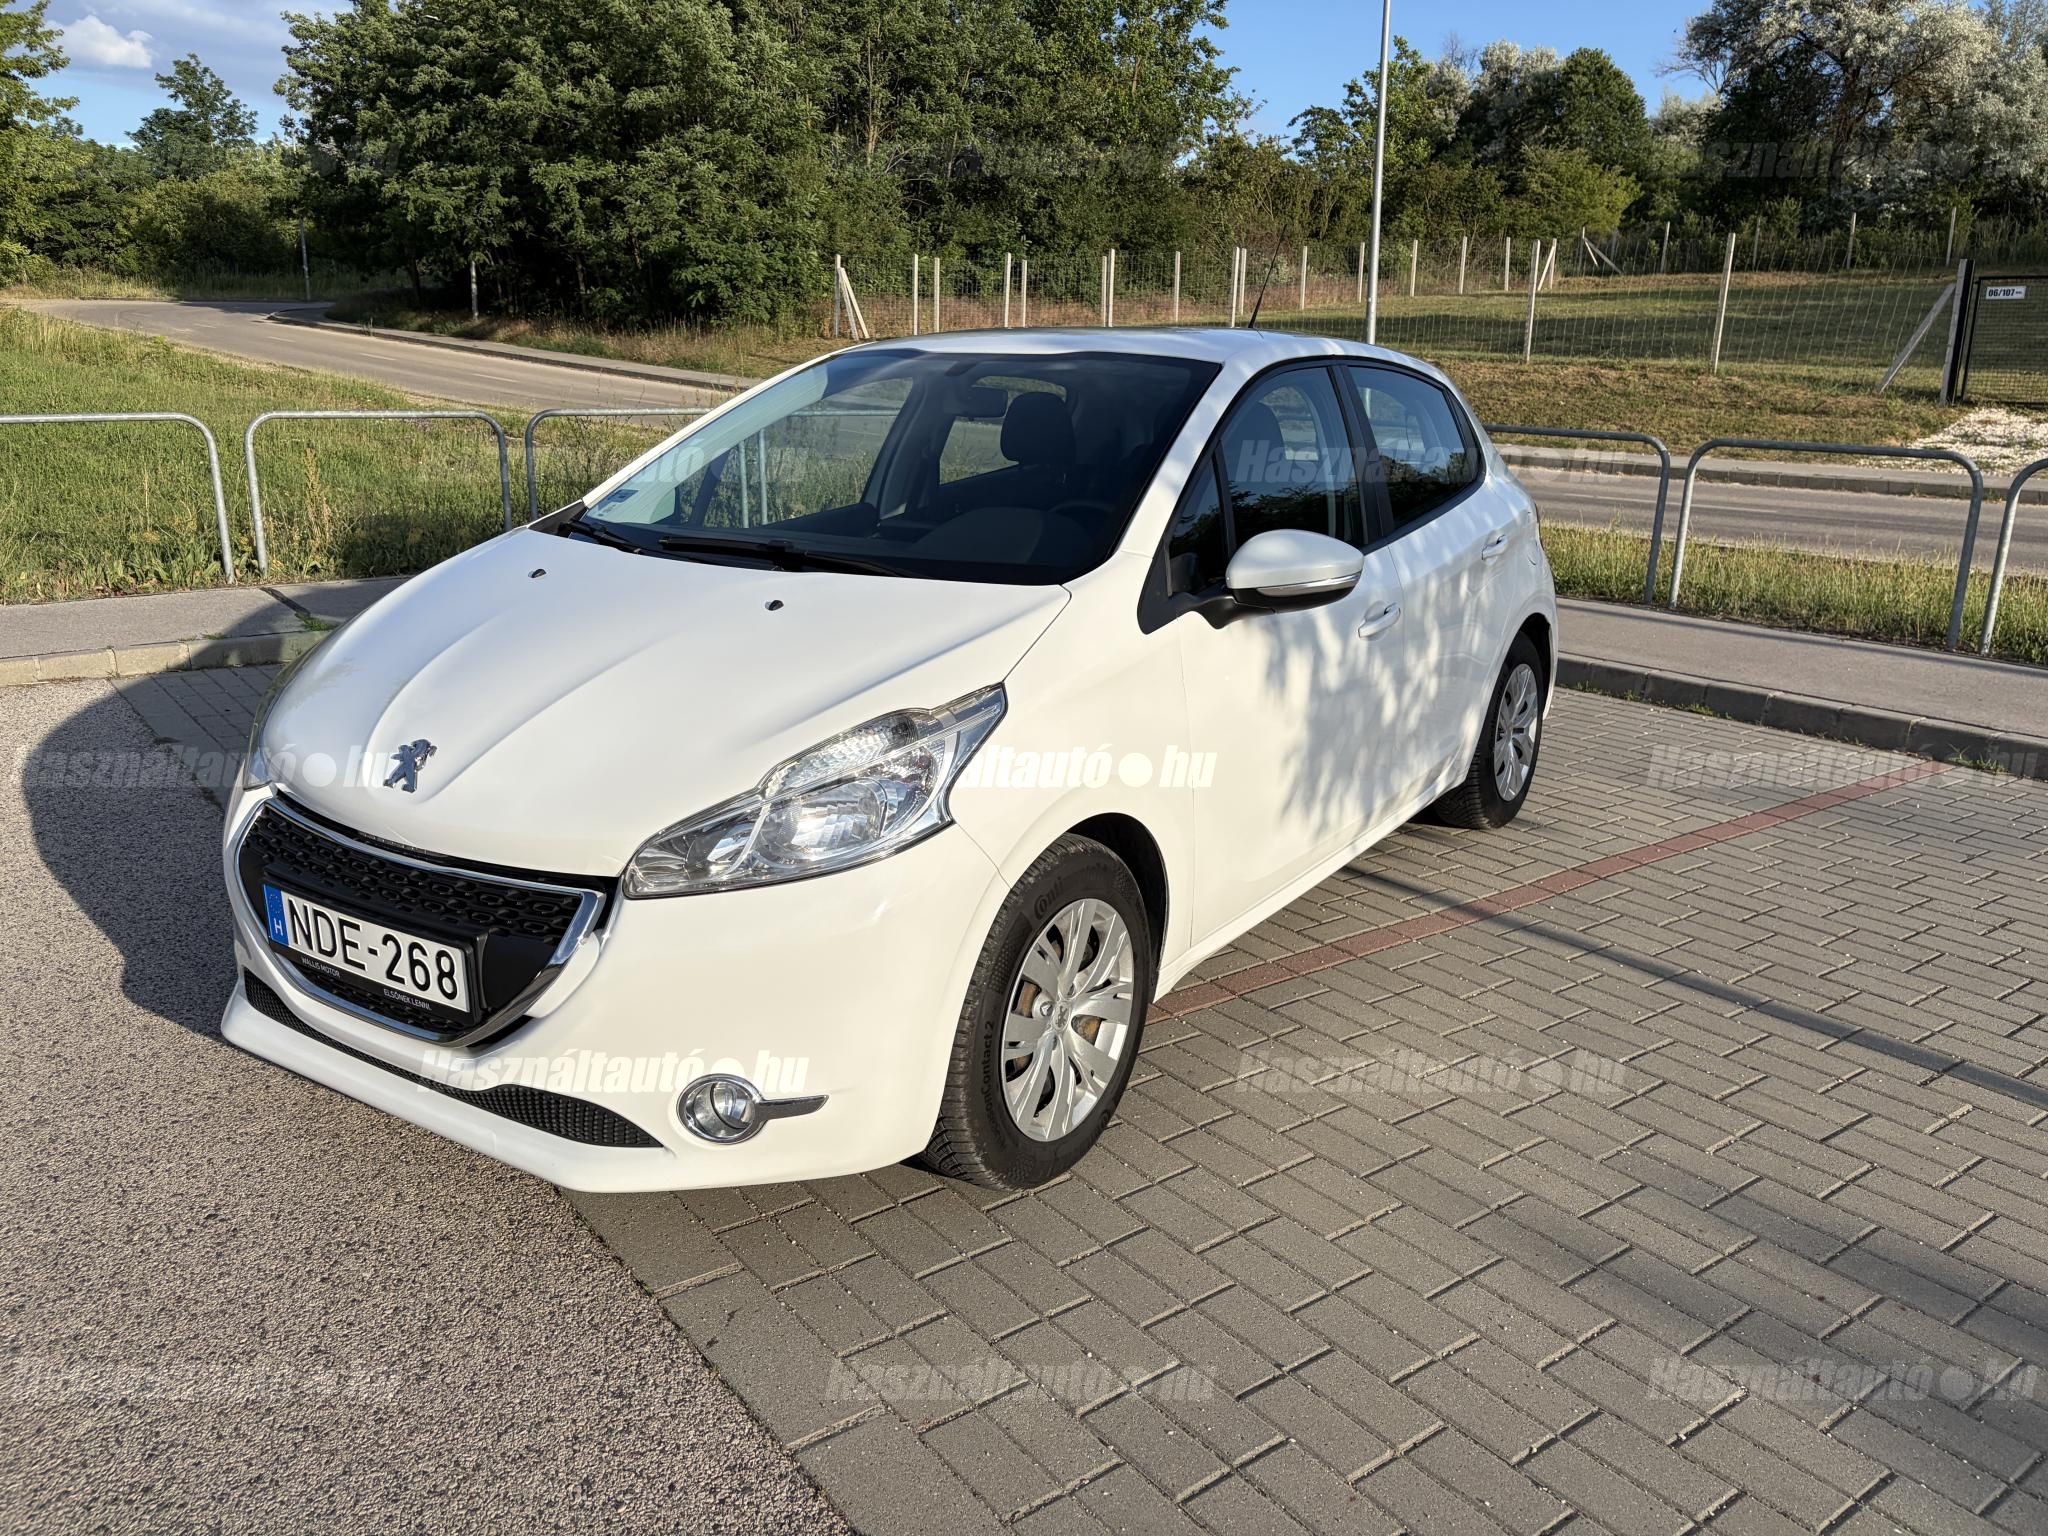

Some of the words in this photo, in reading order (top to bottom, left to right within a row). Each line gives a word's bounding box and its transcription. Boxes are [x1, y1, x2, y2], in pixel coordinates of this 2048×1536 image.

[1988, 288, 2015, 297] 06/107
[274, 918, 284, 936] H
[288, 897, 458, 1000] NDE-268
[301, 956, 321, 972] WALLIS
[320, 963, 341, 979] MOTOR
